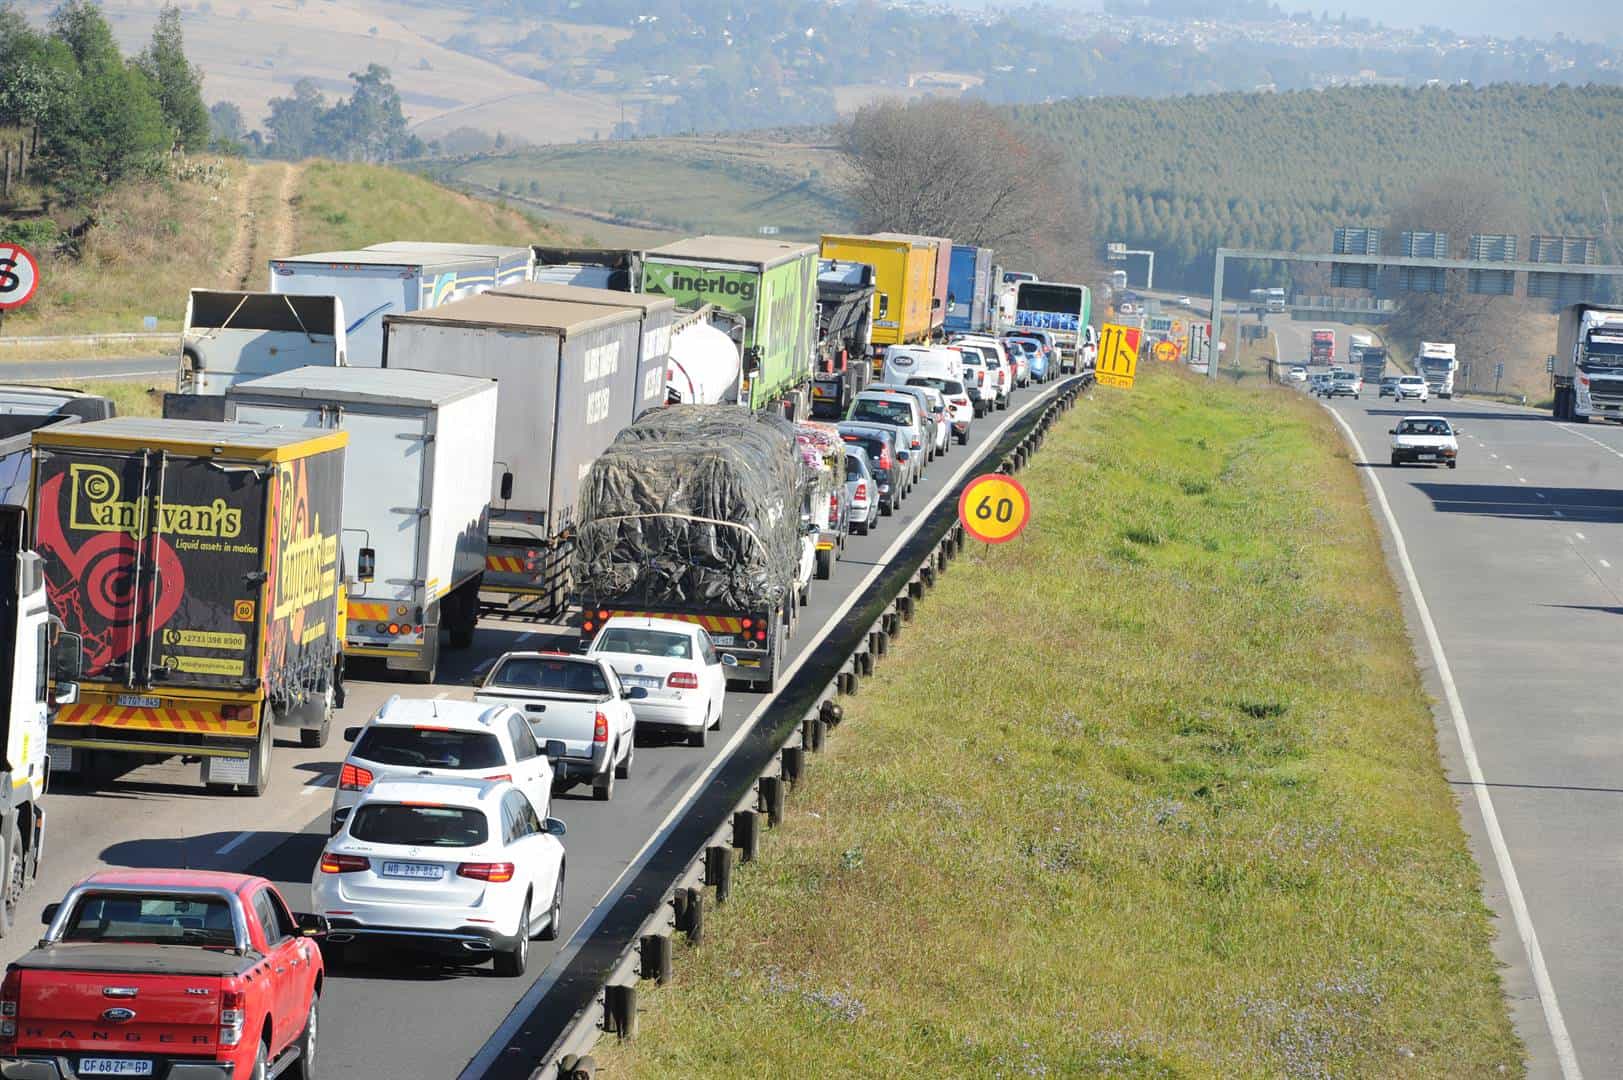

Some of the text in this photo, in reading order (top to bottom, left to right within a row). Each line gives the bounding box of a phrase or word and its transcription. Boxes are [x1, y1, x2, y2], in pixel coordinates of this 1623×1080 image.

[976, 496, 1013, 523] 60
[176, 538, 199, 551] Liquid
[224, 542, 231, 552] in
[232, 544, 257, 554] motion
[26, 1028, 208, 1044] RANGER
[83, 1060, 97, 1072] CF
[99, 1061, 112, 1073] 68
[113, 1061, 126, 1073] ZF
